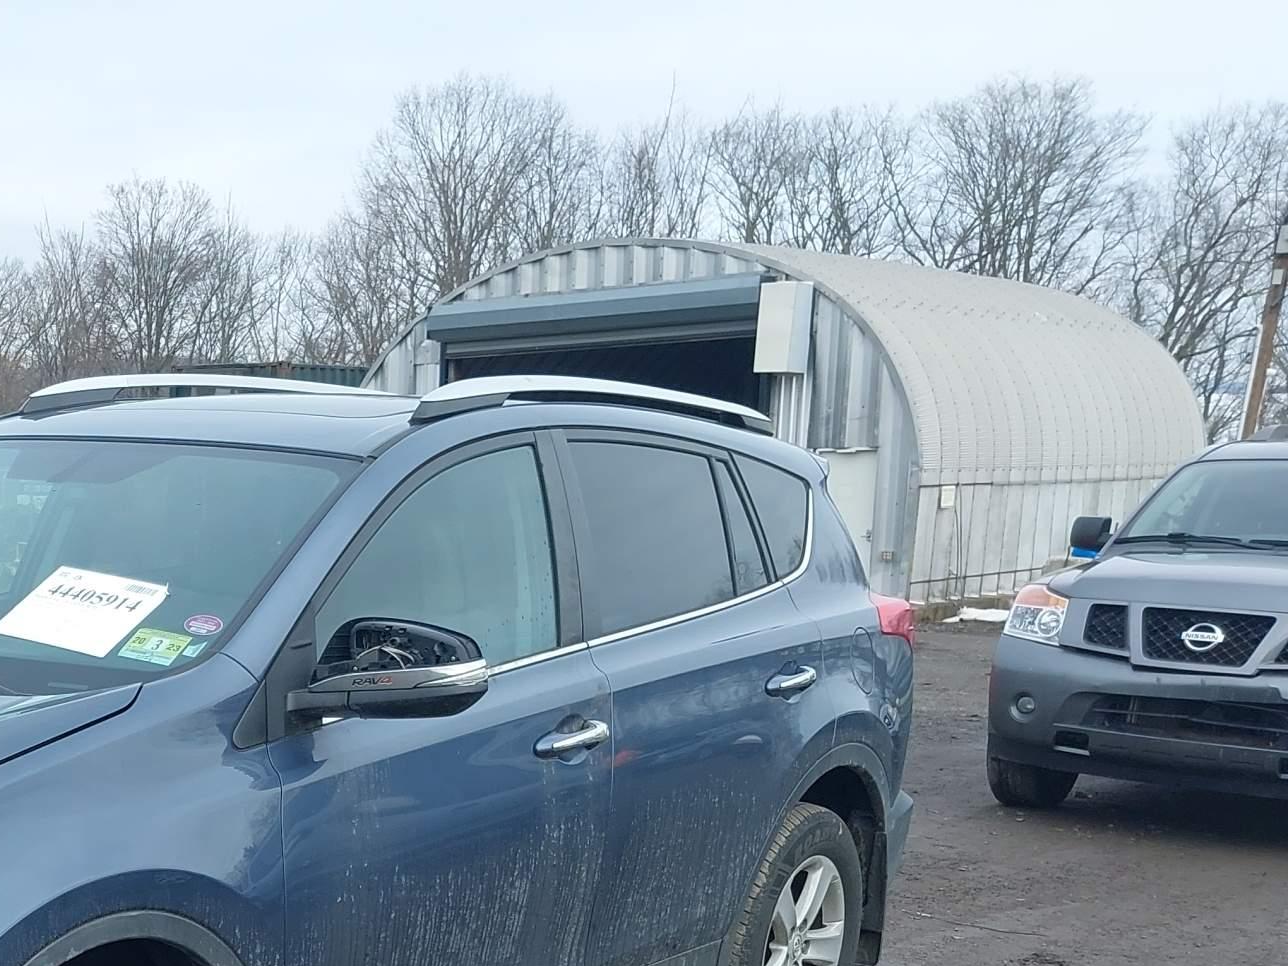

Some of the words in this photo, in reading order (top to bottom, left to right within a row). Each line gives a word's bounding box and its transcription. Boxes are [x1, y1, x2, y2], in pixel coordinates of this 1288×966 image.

[48, 583, 143, 613] 44405914
[1185, 632, 1219, 641] NISSAN
[132, 635, 147, 646] 20
[150, 639, 164, 652] 3
[165, 643, 182, 653] 23
[352, 676, 393, 686] RAV4
